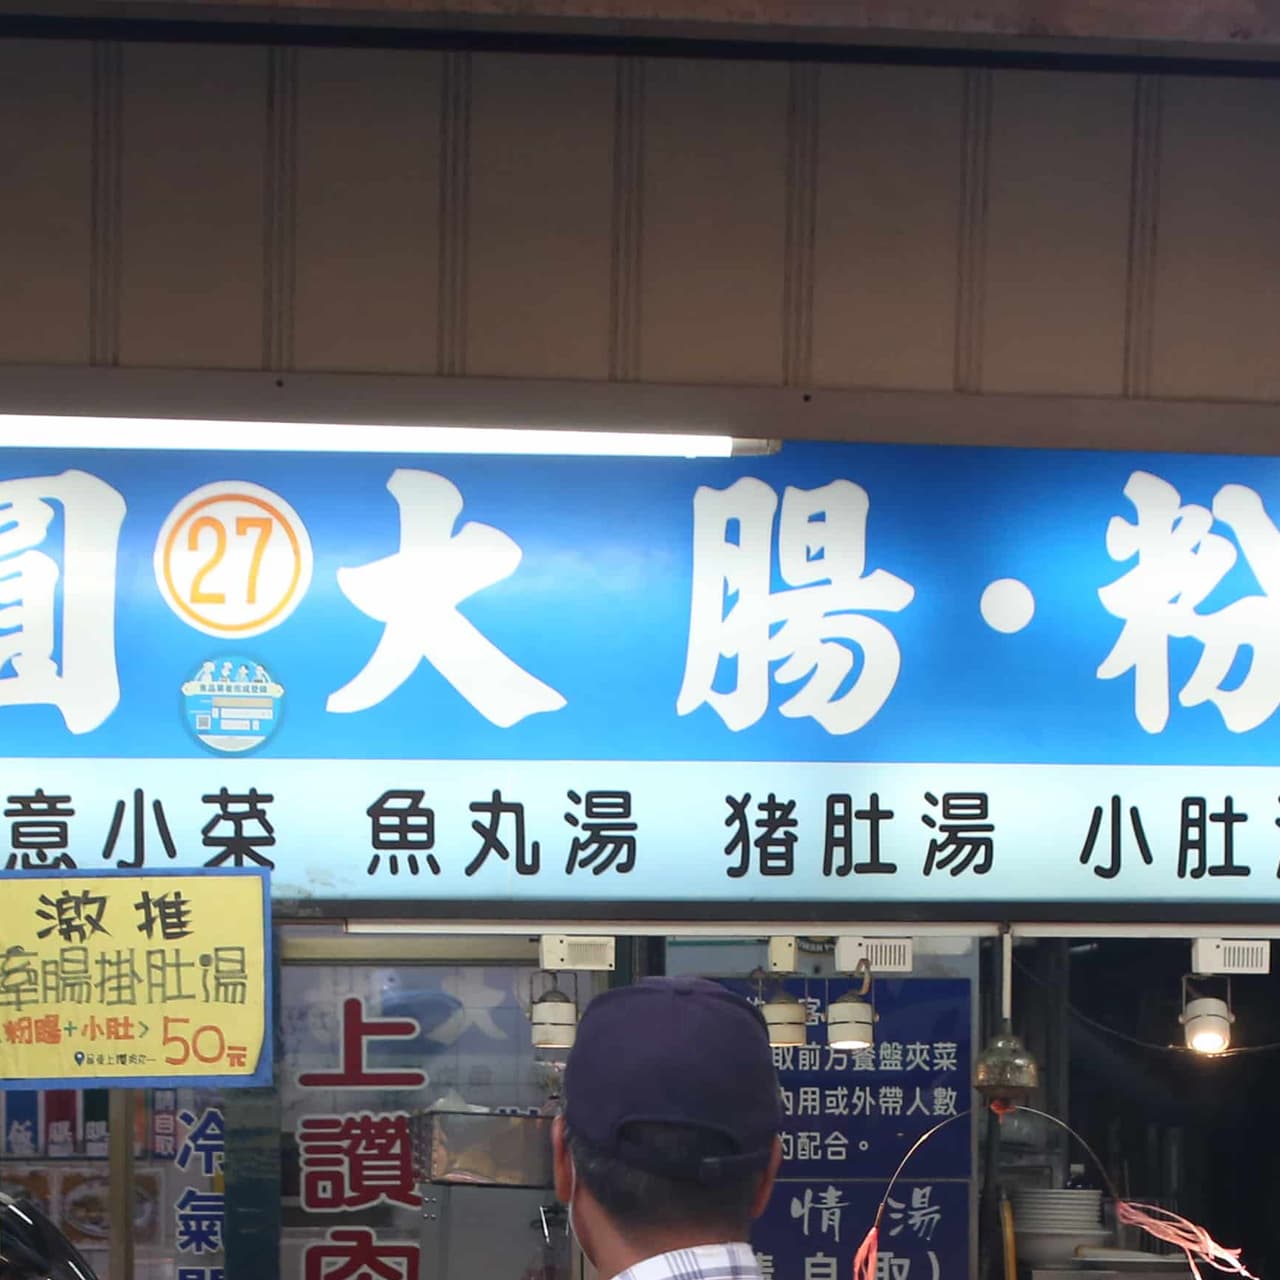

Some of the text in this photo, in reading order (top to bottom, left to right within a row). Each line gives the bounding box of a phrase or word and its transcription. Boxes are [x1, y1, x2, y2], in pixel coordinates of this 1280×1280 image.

[187, 517, 272, 604] 27
[367, 789, 637, 875] 魚丸湯
[35, 890, 194, 940] 激推
[163, 1016, 247, 1067] 50元
